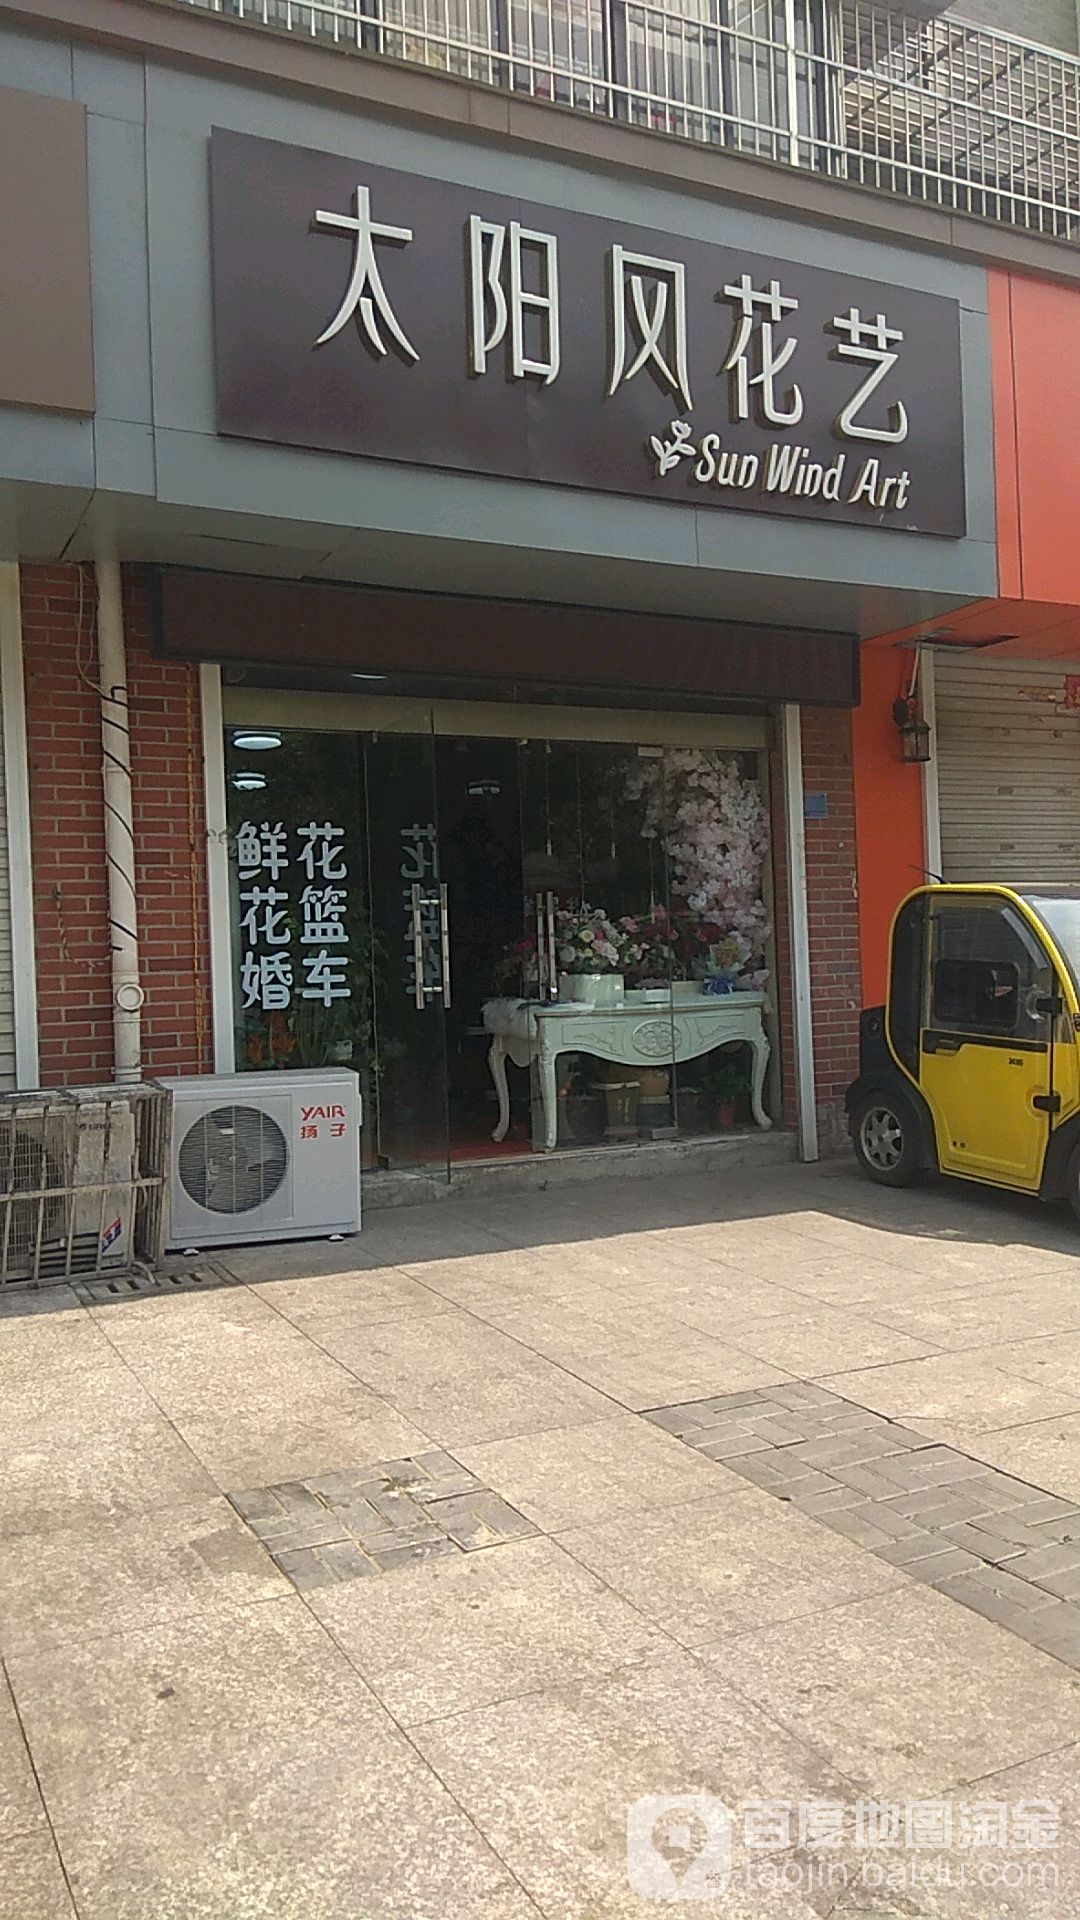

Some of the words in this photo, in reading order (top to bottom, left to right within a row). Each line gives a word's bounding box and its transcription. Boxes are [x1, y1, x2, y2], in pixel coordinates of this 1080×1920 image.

[314, 185, 909, 444] 太阳风花艺
[695, 433, 758, 489] Sun
[766, 443, 846, 501] Wind
[847, 458, 911, 510] Art
[235, 820, 347, 881] 鲜花
[239, 884, 349, 945] 花篮
[240, 949, 351, 1010] 婚车
[300, 1105, 345, 1121] YAIR
